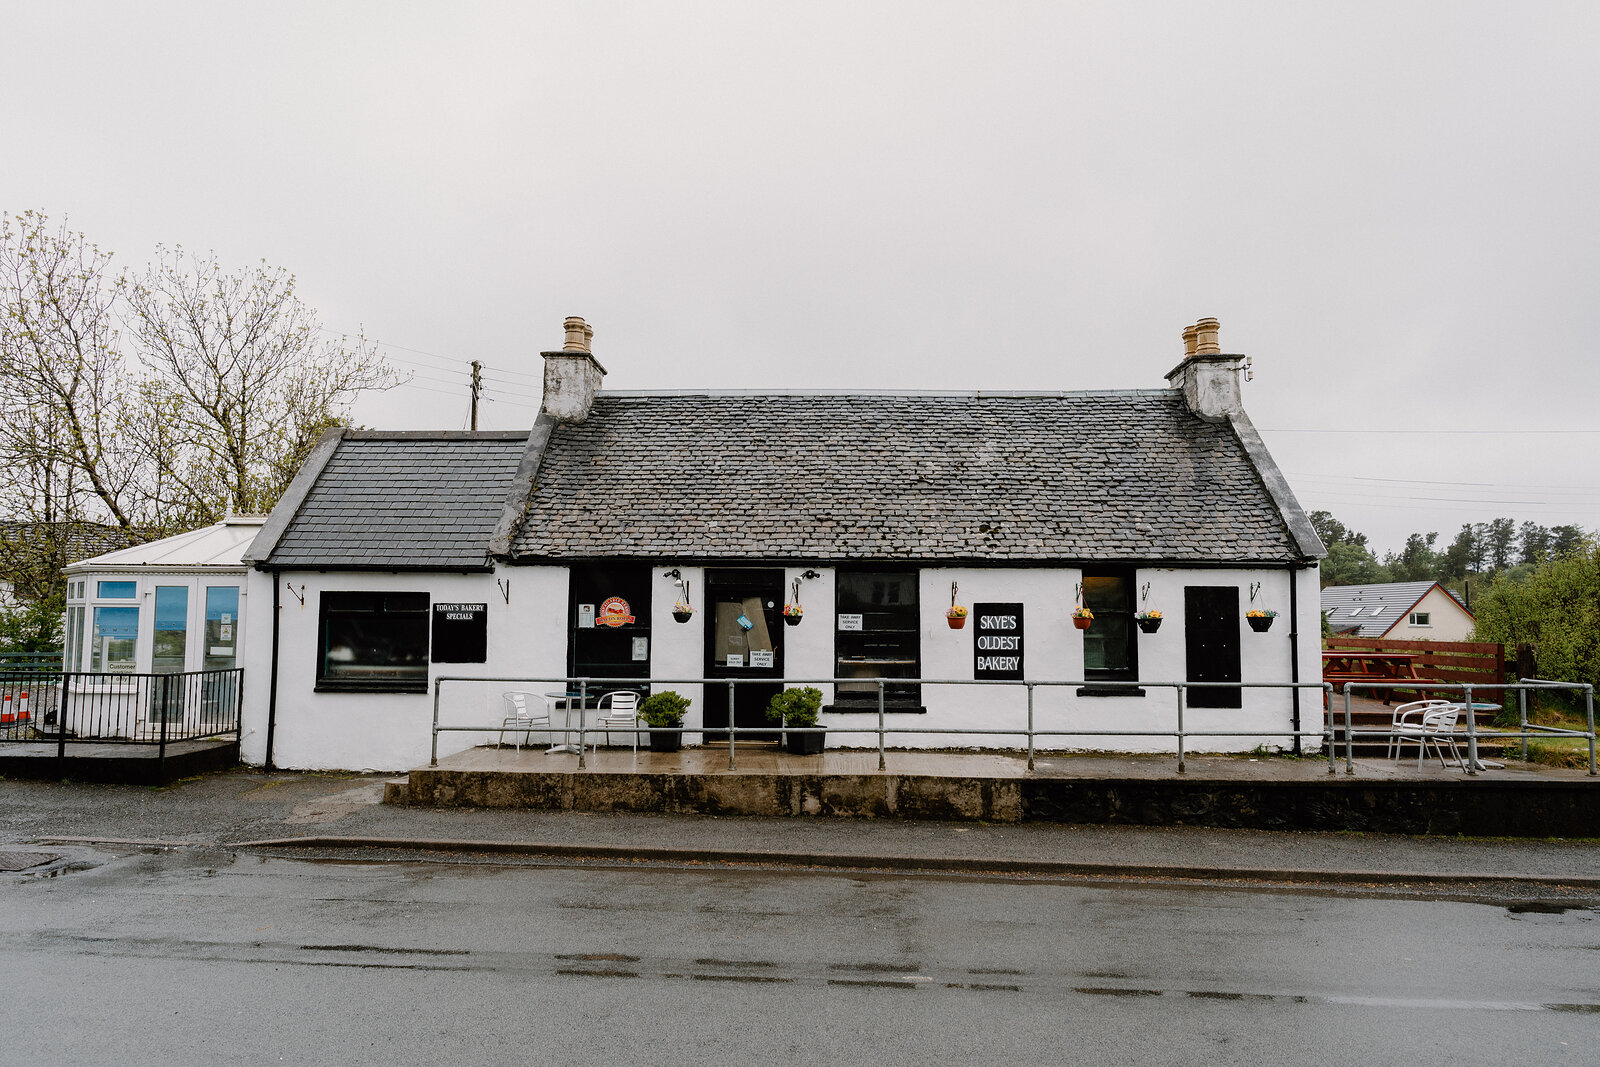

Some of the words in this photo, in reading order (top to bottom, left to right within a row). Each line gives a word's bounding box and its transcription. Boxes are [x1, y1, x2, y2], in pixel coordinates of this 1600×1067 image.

[980, 615, 1017, 630] SKYE'S
[978, 636, 1020, 650] OLDEST
[978, 656, 1020, 670] BAKERY
